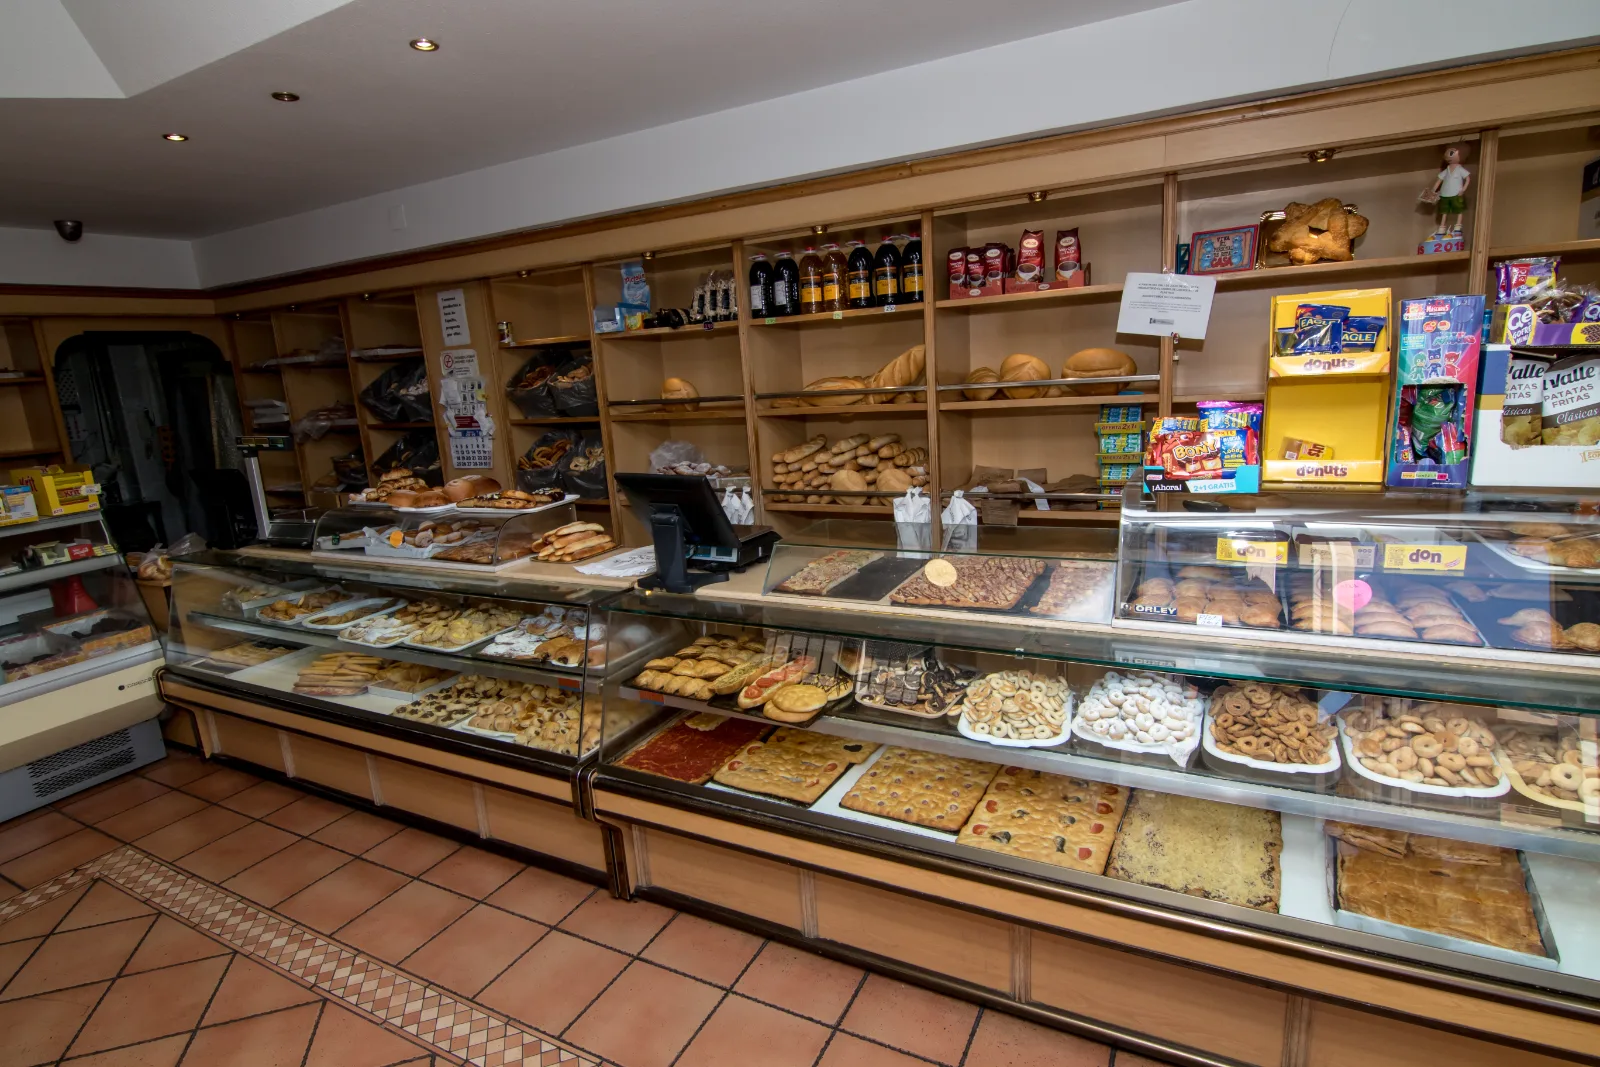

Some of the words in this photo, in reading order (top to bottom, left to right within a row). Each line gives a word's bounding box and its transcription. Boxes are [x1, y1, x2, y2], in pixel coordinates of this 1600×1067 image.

[1304, 359, 1355, 371] donuts
[1550, 366, 1595, 388] Valle
[1506, 383, 1538, 391] ATAS
[1544, 384, 1593, 402] PATATAS
[1552, 393, 1590, 408] FRITAS
[1503, 406, 1532, 415] lásicas
[1557, 408, 1598, 424] Clásicas
[1174, 440, 1217, 458] BONY
[1296, 465, 1347, 477] donuts
[1409, 549, 1441, 564] don
[1135, 605, 1177, 615] ORLEY
